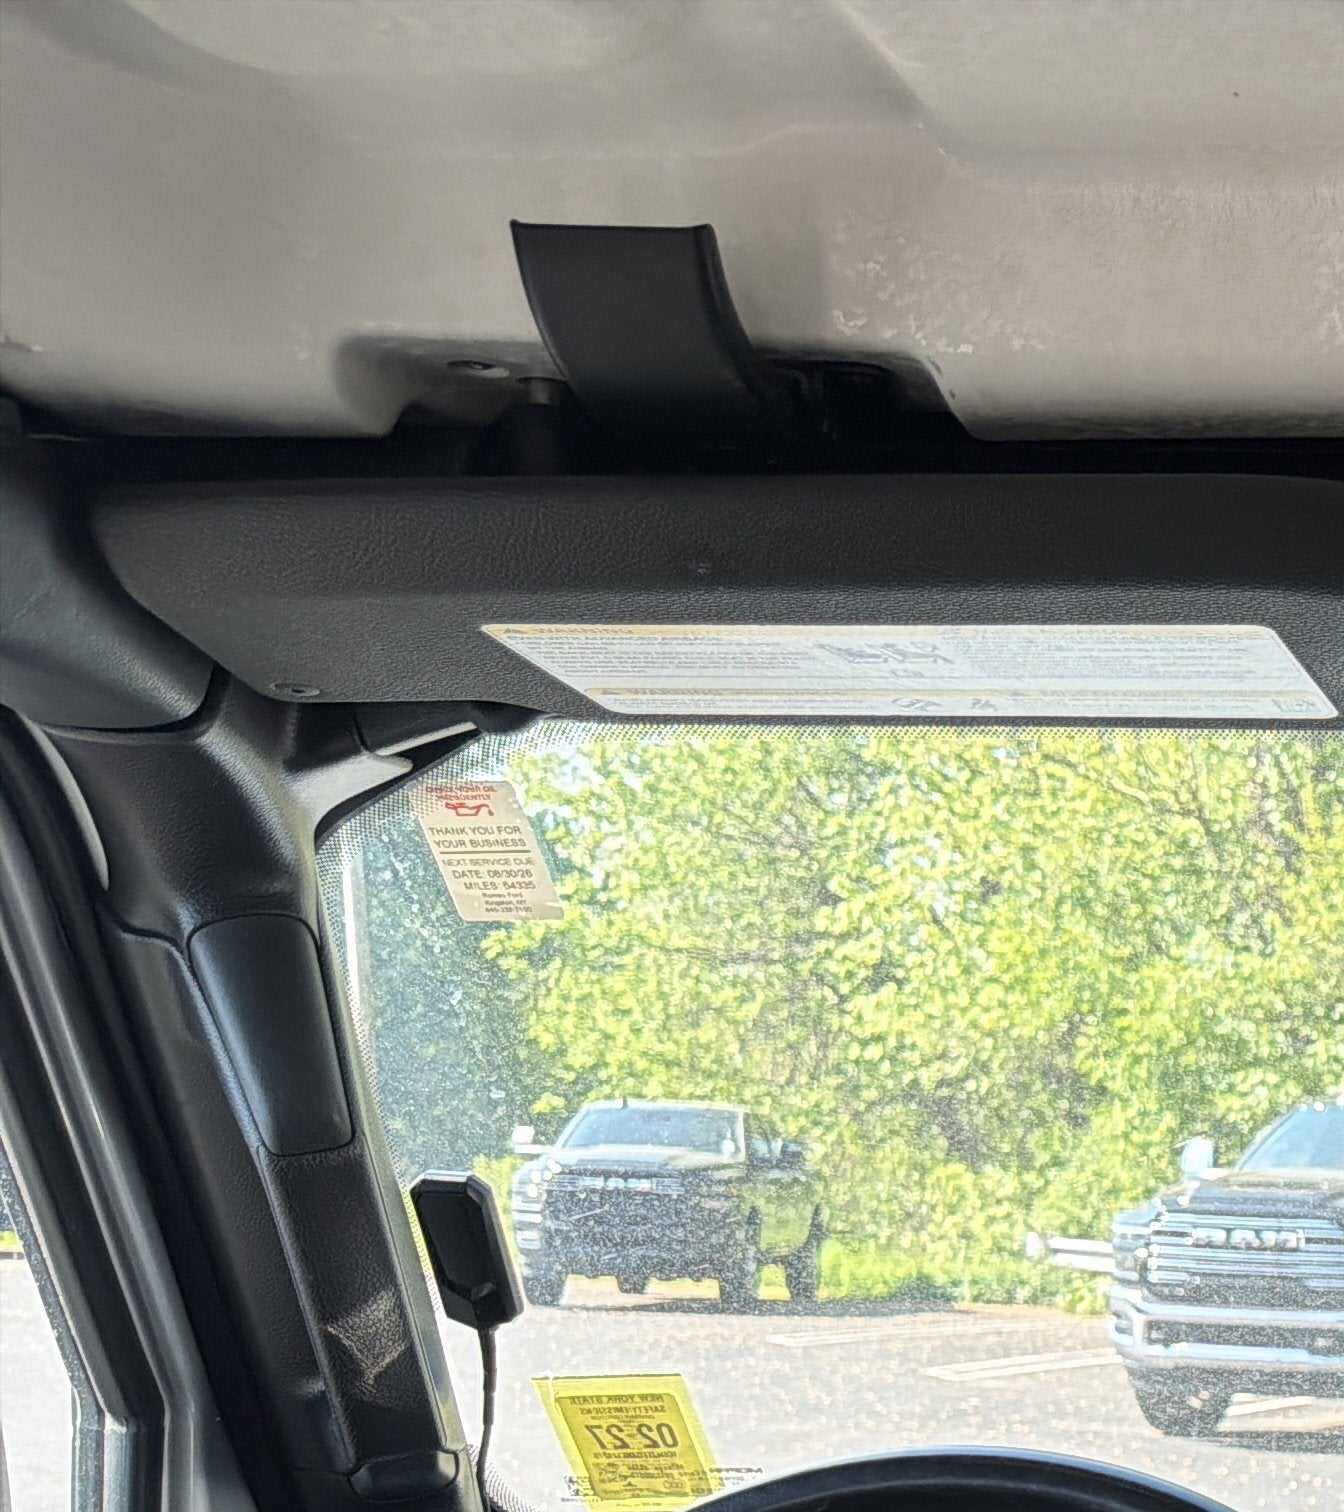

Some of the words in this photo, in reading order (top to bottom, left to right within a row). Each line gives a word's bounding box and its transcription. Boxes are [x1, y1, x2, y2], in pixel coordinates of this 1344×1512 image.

[429, 827, 468, 835] THANK
[469, 826, 494, 835] YOU
[497, 825, 521, 835] FOR
[434, 840, 467, 848] YOUR
[469, 839, 527, 848] BUSINESS
[442, 858, 468, 866] NEXT
[469, 858, 512, 866] SERVICE
[514, 858, 535, 866] DUE
